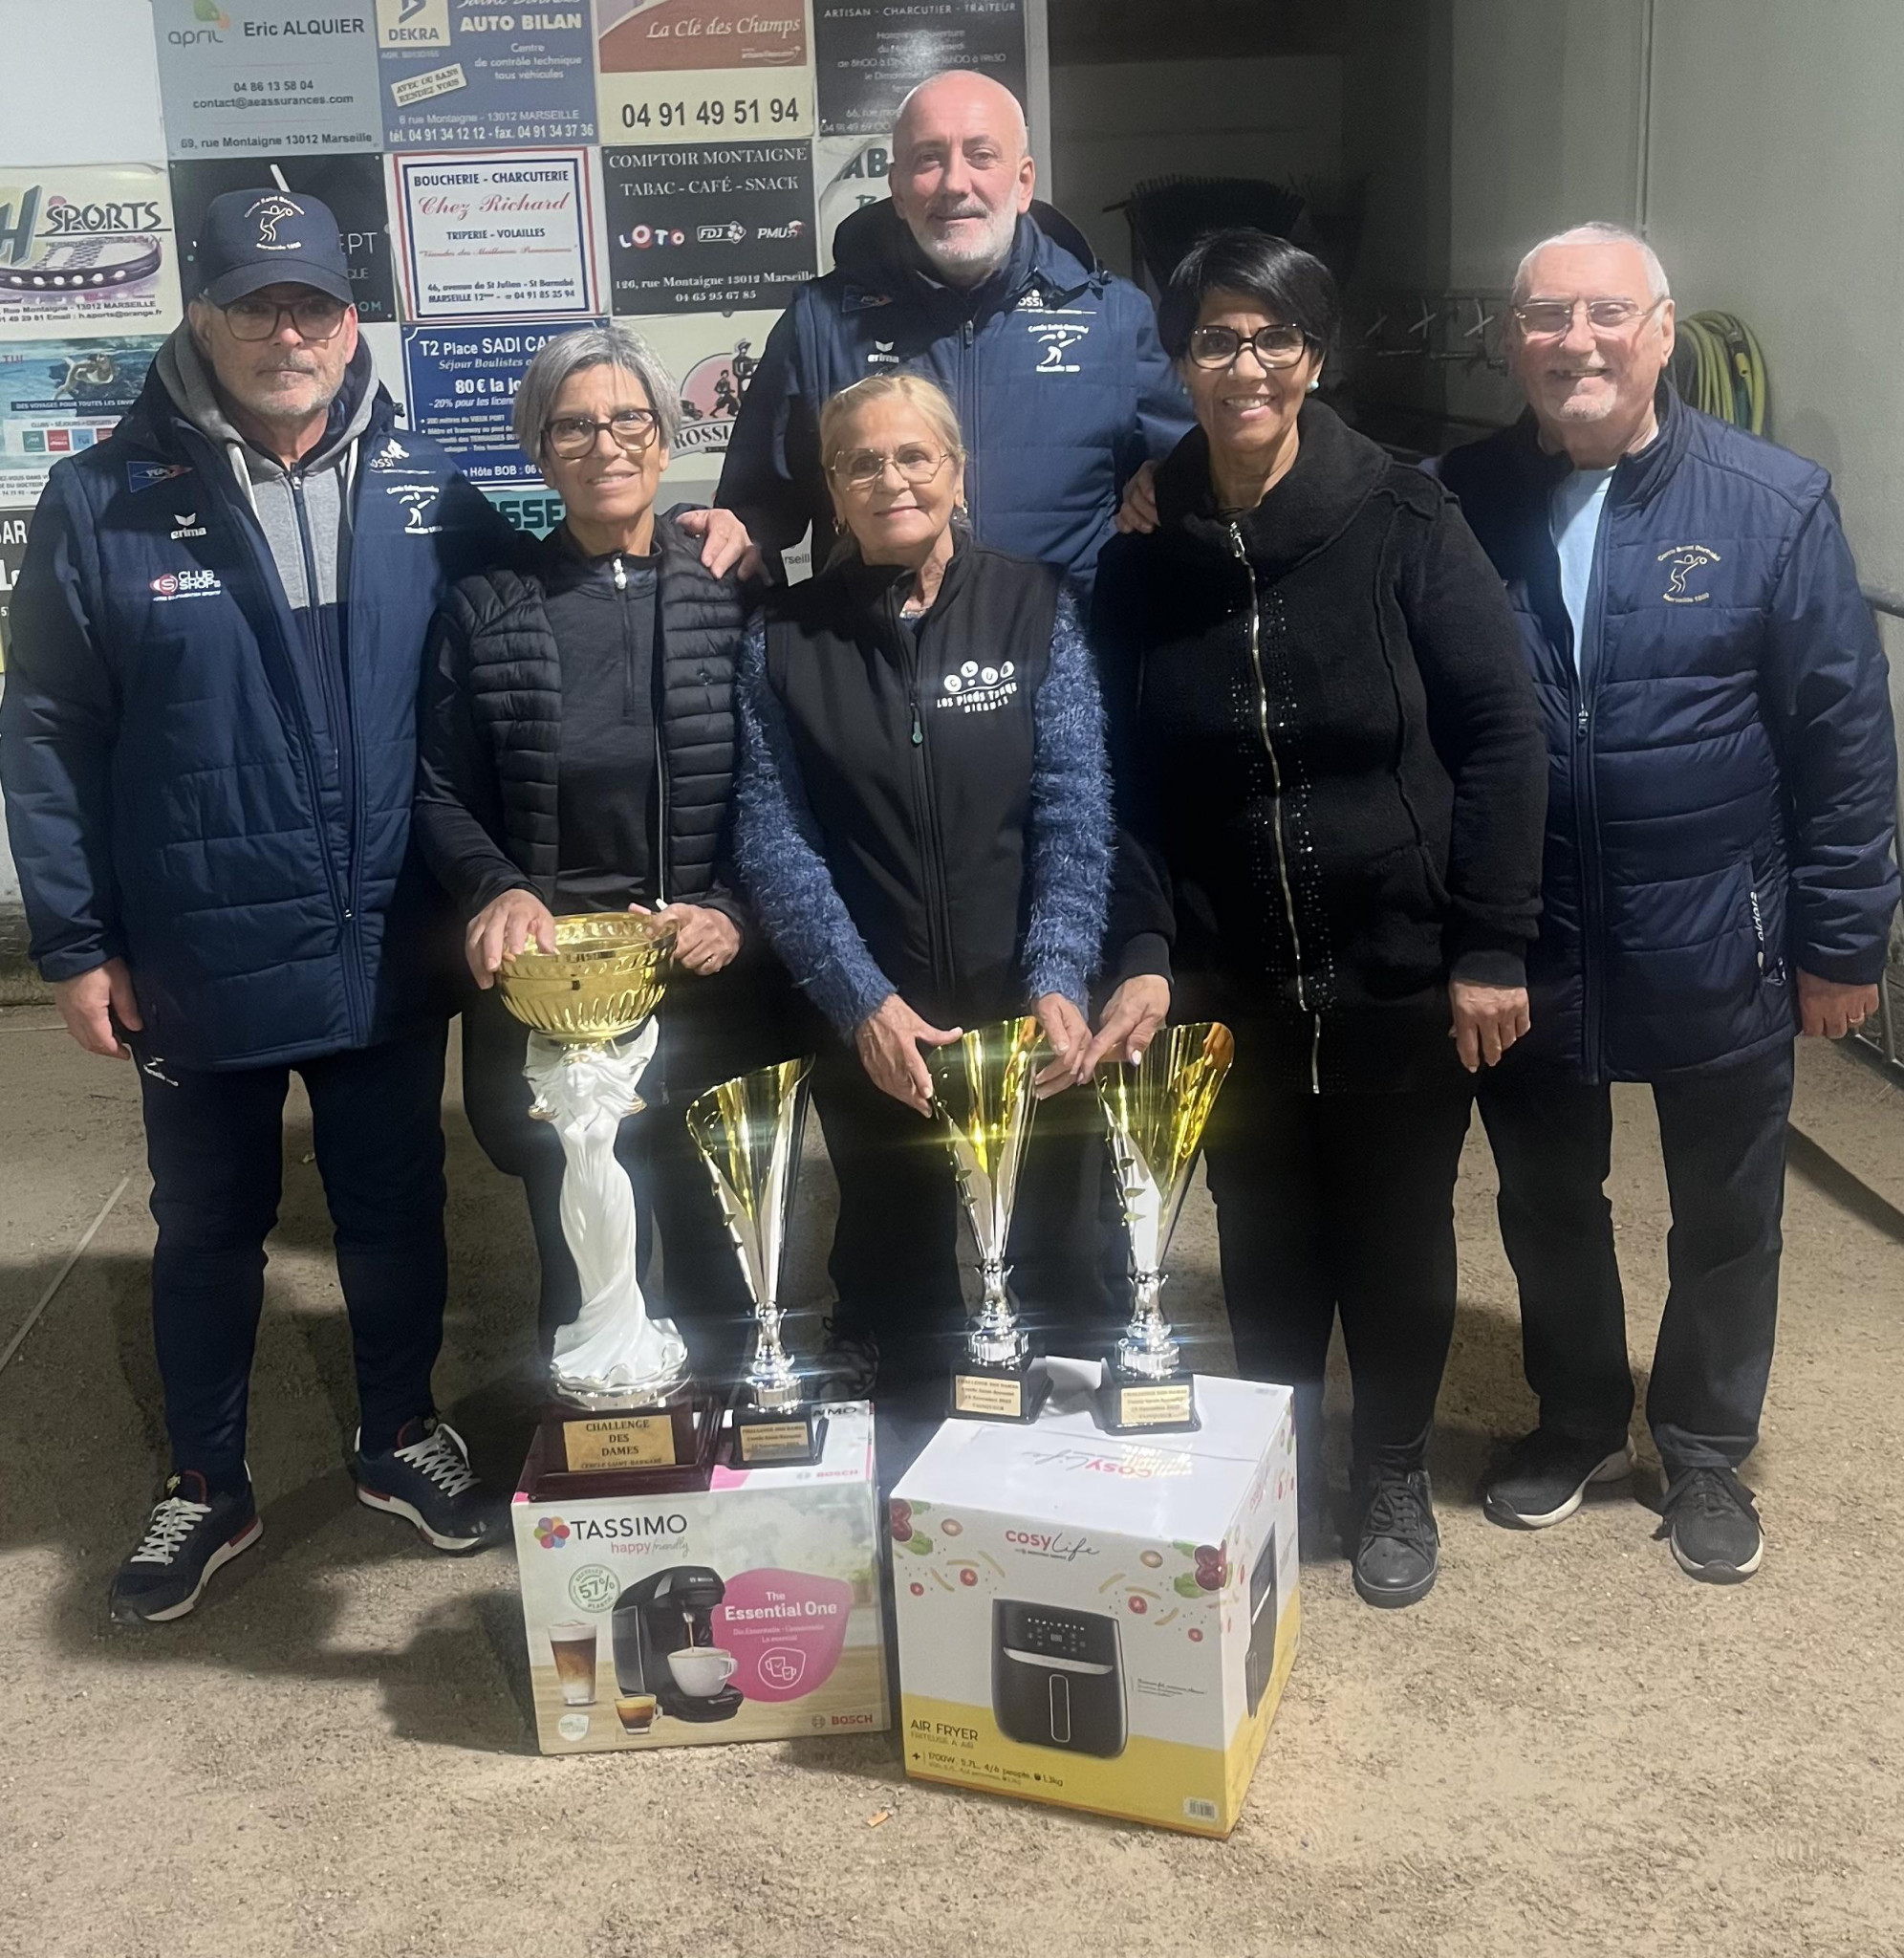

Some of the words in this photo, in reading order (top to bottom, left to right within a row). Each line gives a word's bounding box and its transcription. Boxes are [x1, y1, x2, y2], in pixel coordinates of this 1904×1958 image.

[824, 8, 871, 18] ARTISAN
[883, 5, 952, 16] CHARCUTIER
[964, 2, 1016, 13] TRAITEUR
[244, 21, 278, 36] Eric
[284, 19, 364, 35] ALQUIER
[460, 15, 514, 32] AUTO
[522, 13, 581, 30] BILAN
[646, 21, 669, 38] La
[675, 18, 702, 36] Clé
[706, 17, 731, 34] des
[737, 14, 801, 39] Champs
[168, 30, 224, 47] april
[389, 28, 440, 40] DEKRA
[510, 43, 545, 53] Centre
[475, 57, 487, 67] de
[490, 56, 530, 67] contrôle
[533, 55, 582, 66] technique
[396, 79, 419, 94] AVEC
[436, 68, 458, 79] SANS
[495, 71, 516, 79] tous
[234, 82, 247, 92] 04
[250, 82, 264, 92] 86
[268, 81, 280, 91] 13
[300, 80, 314, 90] 04
[399, 87, 435, 103] RENDEZ
[437, 79, 459, 92] VOUS
[193, 95, 353, 109] contact@aeassurances.com
[408, 116, 423, 124] rue
[427, 114, 477, 125] Montaigne
[487, 112, 516, 121] 13012
[520, 110, 579, 120] MARSEILLE
[622, 102, 651, 128] 04
[659, 101, 684, 127] 91
[697, 100, 724, 125] 49
[734, 99, 759, 124] 51
[770, 98, 799, 123] 94
[390, 129, 406, 142] tél.
[409, 129, 422, 141] 04
[424, 129, 437, 141] 91
[441, 128, 453, 141] 34
[457, 128, 469, 140] 12
[473, 127, 486, 139] 12
[495, 125, 515, 139] fax.
[518, 126, 530, 138] 04
[534, 125, 546, 138] 91
[550, 125, 562, 137] 34
[566, 124, 577, 137] 37
[581, 123, 594, 136] 36
[223, 137, 281, 147] Montaigne
[286, 135, 318, 144] 13012
[322, 133, 372, 143] Marseille
[610, 152, 698, 168] COMPTOIR
[703, 147, 807, 164] MONTAIGNE
[414, 174, 480, 186] BOUCHERIE
[491, 171, 569, 184] CHARCUTERIE
[620, 182, 676, 196] TABAC
[688, 176, 732, 193] CAFÉ
[746, 176, 798, 191] SNACK
[419, 195, 470, 221] Chez
[479, 192, 571, 212] Richard
[45, 201, 162, 234] SPORTS
[446, 230, 487, 240] TRIPERIE
[497, 228, 545, 238] VOLAILLES
[619, 225, 684, 249] LOTO
[700, 228, 723, 239] FDJ
[758, 228, 788, 239] PMU
[497, 279, 521, 288] Julien
[641, 279, 660, 288] rue
[663, 276, 724, 289] Montaigne
[727, 275, 760, 285] 13012
[764, 272, 815, 283] Marseille
[429, 294, 471, 303] MARSEILLE
[79, 309, 162, 318] h.sports@orange.fr
[420, 340, 439, 356] T2
[444, 341, 478, 356] Place
[483, 337, 520, 354] SADI
[439, 359, 472, 372] Séjour
[475, 358, 523, 368] Boulistes
[868, 354, 899, 363] erima
[455, 380, 474, 394] 80
[477, 379, 486, 393] €
[490, 379, 504, 392] la
[429, 399, 453, 408] -20%
[455, 398, 474, 409] pour
[477, 398, 489, 406] les
[470, 467, 492, 476] Hôte
[494, 466, 517, 475] BOB
[170, 527, 206, 539] erima
[178, 570, 214, 581] CLUB
[586, 1419, 650, 1432] CHALLENGE
[609, 1434, 629, 1443] DES
[602, 1446, 639, 1456] DAMES
[570, 1514, 687, 1540] TASSIMO
[579, 1576, 616, 1599] 57%
[766, 1591, 785, 1601] The
[725, 1602, 802, 1621] Essential
[805, 1601, 837, 1616] One
[831, 1713, 874, 1726] BOSCH
[910, 1719, 931, 1732] AIR
[937, 1723, 979, 1741] FRYER
